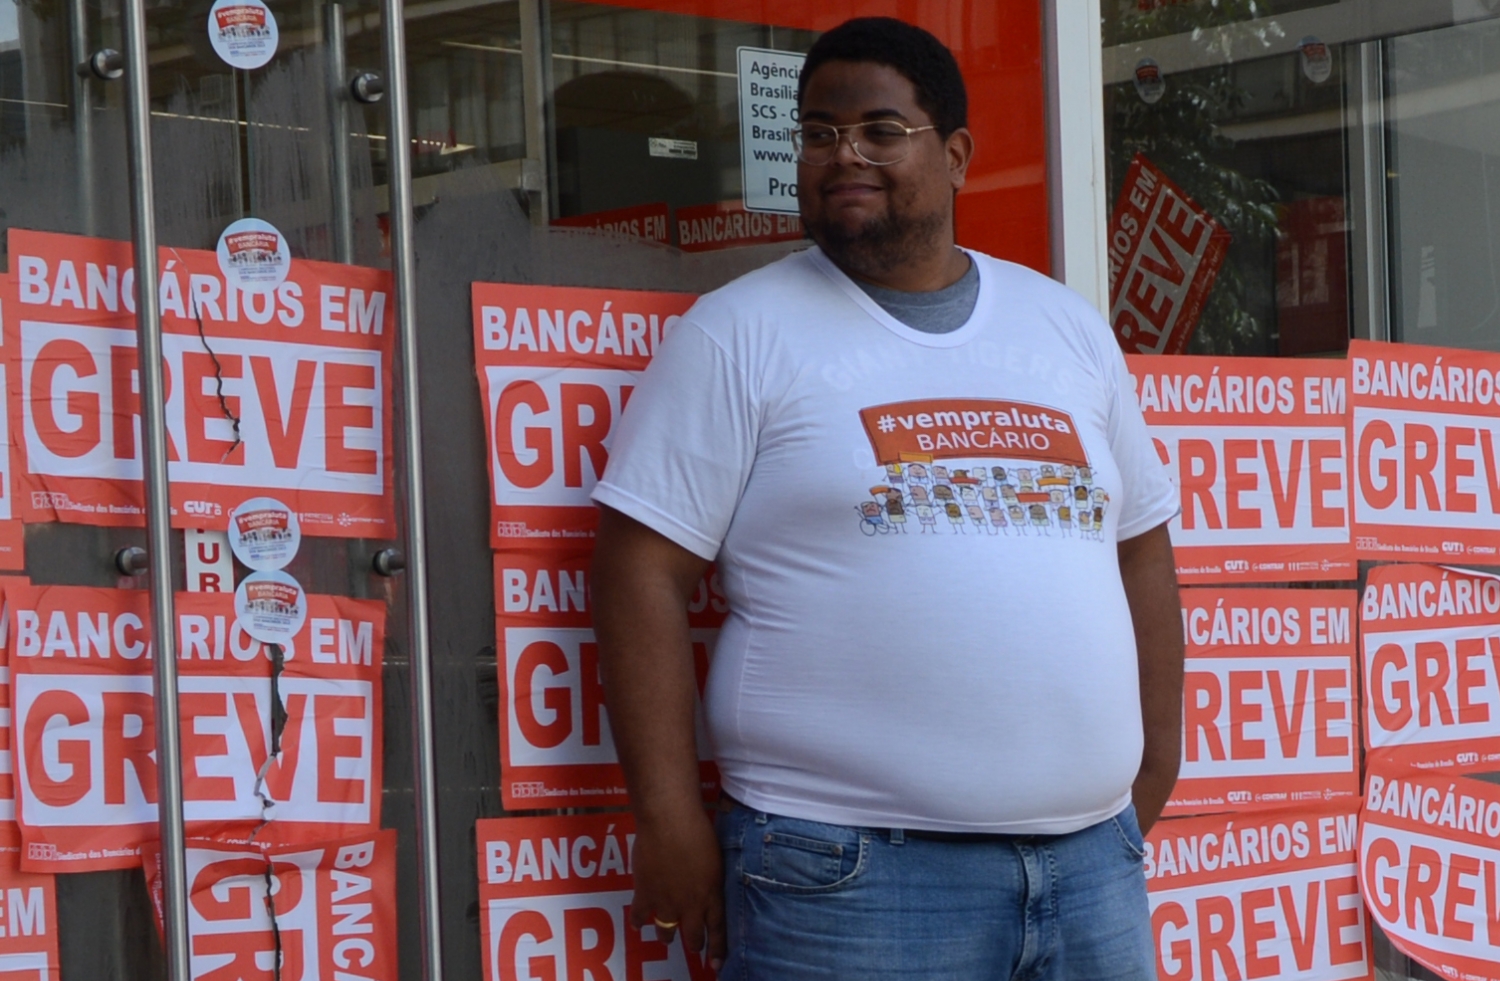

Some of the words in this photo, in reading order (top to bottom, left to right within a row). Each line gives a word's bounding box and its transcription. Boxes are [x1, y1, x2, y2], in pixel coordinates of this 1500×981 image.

[751, 61, 800, 80] Agênci
[752, 104, 777, 119] SCS
[752, 125, 793, 142] Brasíl
[753, 150, 798, 164] www.
[320, 284, 385, 336] EM
[481, 301, 682, 357] BANCÁRI
[31, 338, 379, 476] GREVE
[1304, 376, 1347, 415] EM
[877, 408, 1071, 434] #vempraluta
[916, 428, 1049, 450] BANCÁRIO
[1156, 435, 1346, 531] REVE
[183, 500, 213, 515] CUT
[1225, 560, 1244, 572] CUT
[311, 618, 373, 666] EM
[1310, 607, 1350, 645] EM
[1184, 668, 1349, 762] REVE
[23, 690, 367, 807] GREVE
[1319, 813, 1358, 853] EM
